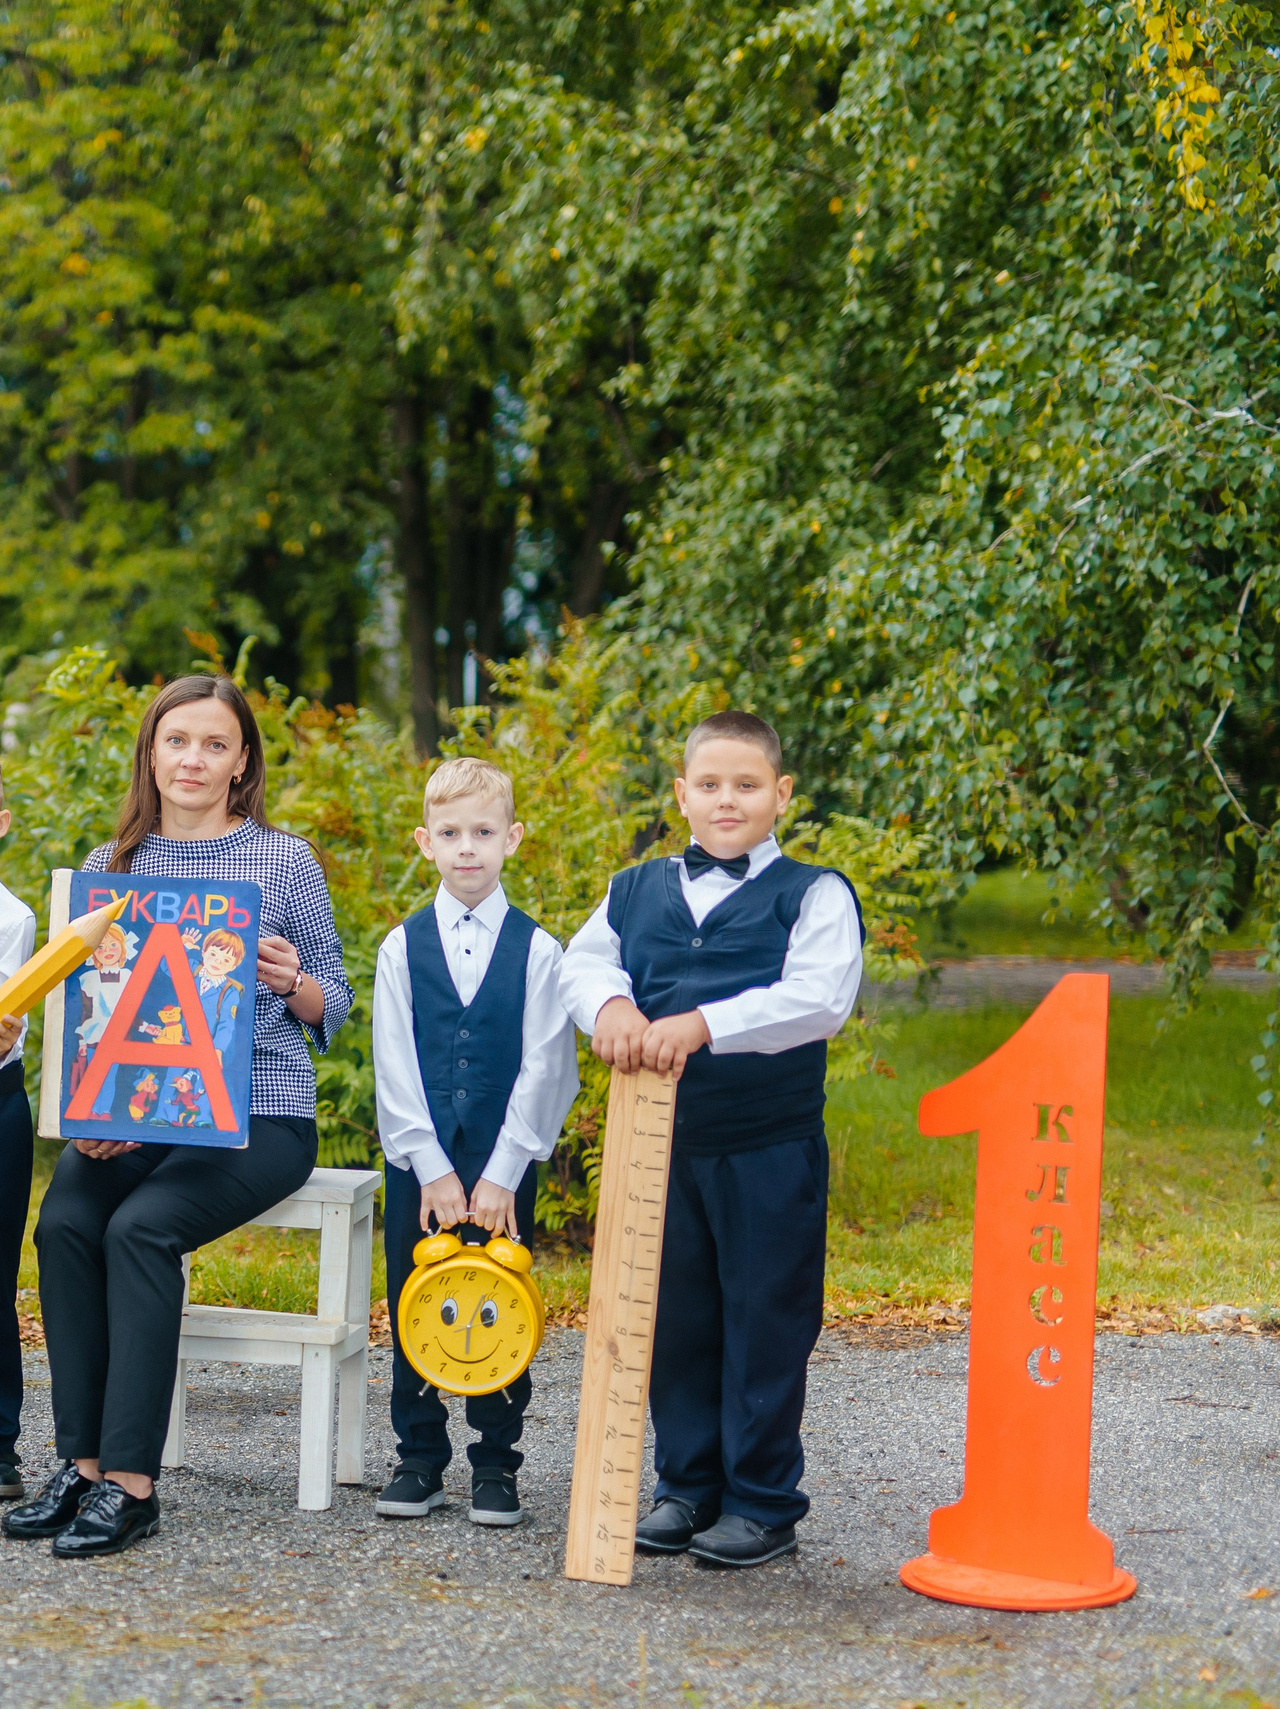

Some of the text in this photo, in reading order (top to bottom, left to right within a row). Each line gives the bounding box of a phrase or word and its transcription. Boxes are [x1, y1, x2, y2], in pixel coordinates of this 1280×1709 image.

[1025, 1102, 1075, 1388] класс
[438, 1276, 451, 1286] 11
[463, 1271, 478, 1281] 12
[493, 1280, 500, 1289] 1
[418, 1293, 433, 1304] 10
[509, 1299, 519, 1309] 2
[412, 1318, 420, 1329] 9
[516, 1324, 526, 1334] 3
[594, 1093, 649, 1575] 2 3 4 5 6 7 8 9 10 11 12 13 14 15 16
[420, 1343, 429, 1354] 8
[510, 1349, 520, 1360] 4
[439, 1362, 447, 1373] 7
[489, 1367, 499, 1377] 5
[463, 1371, 472, 1382] 6
